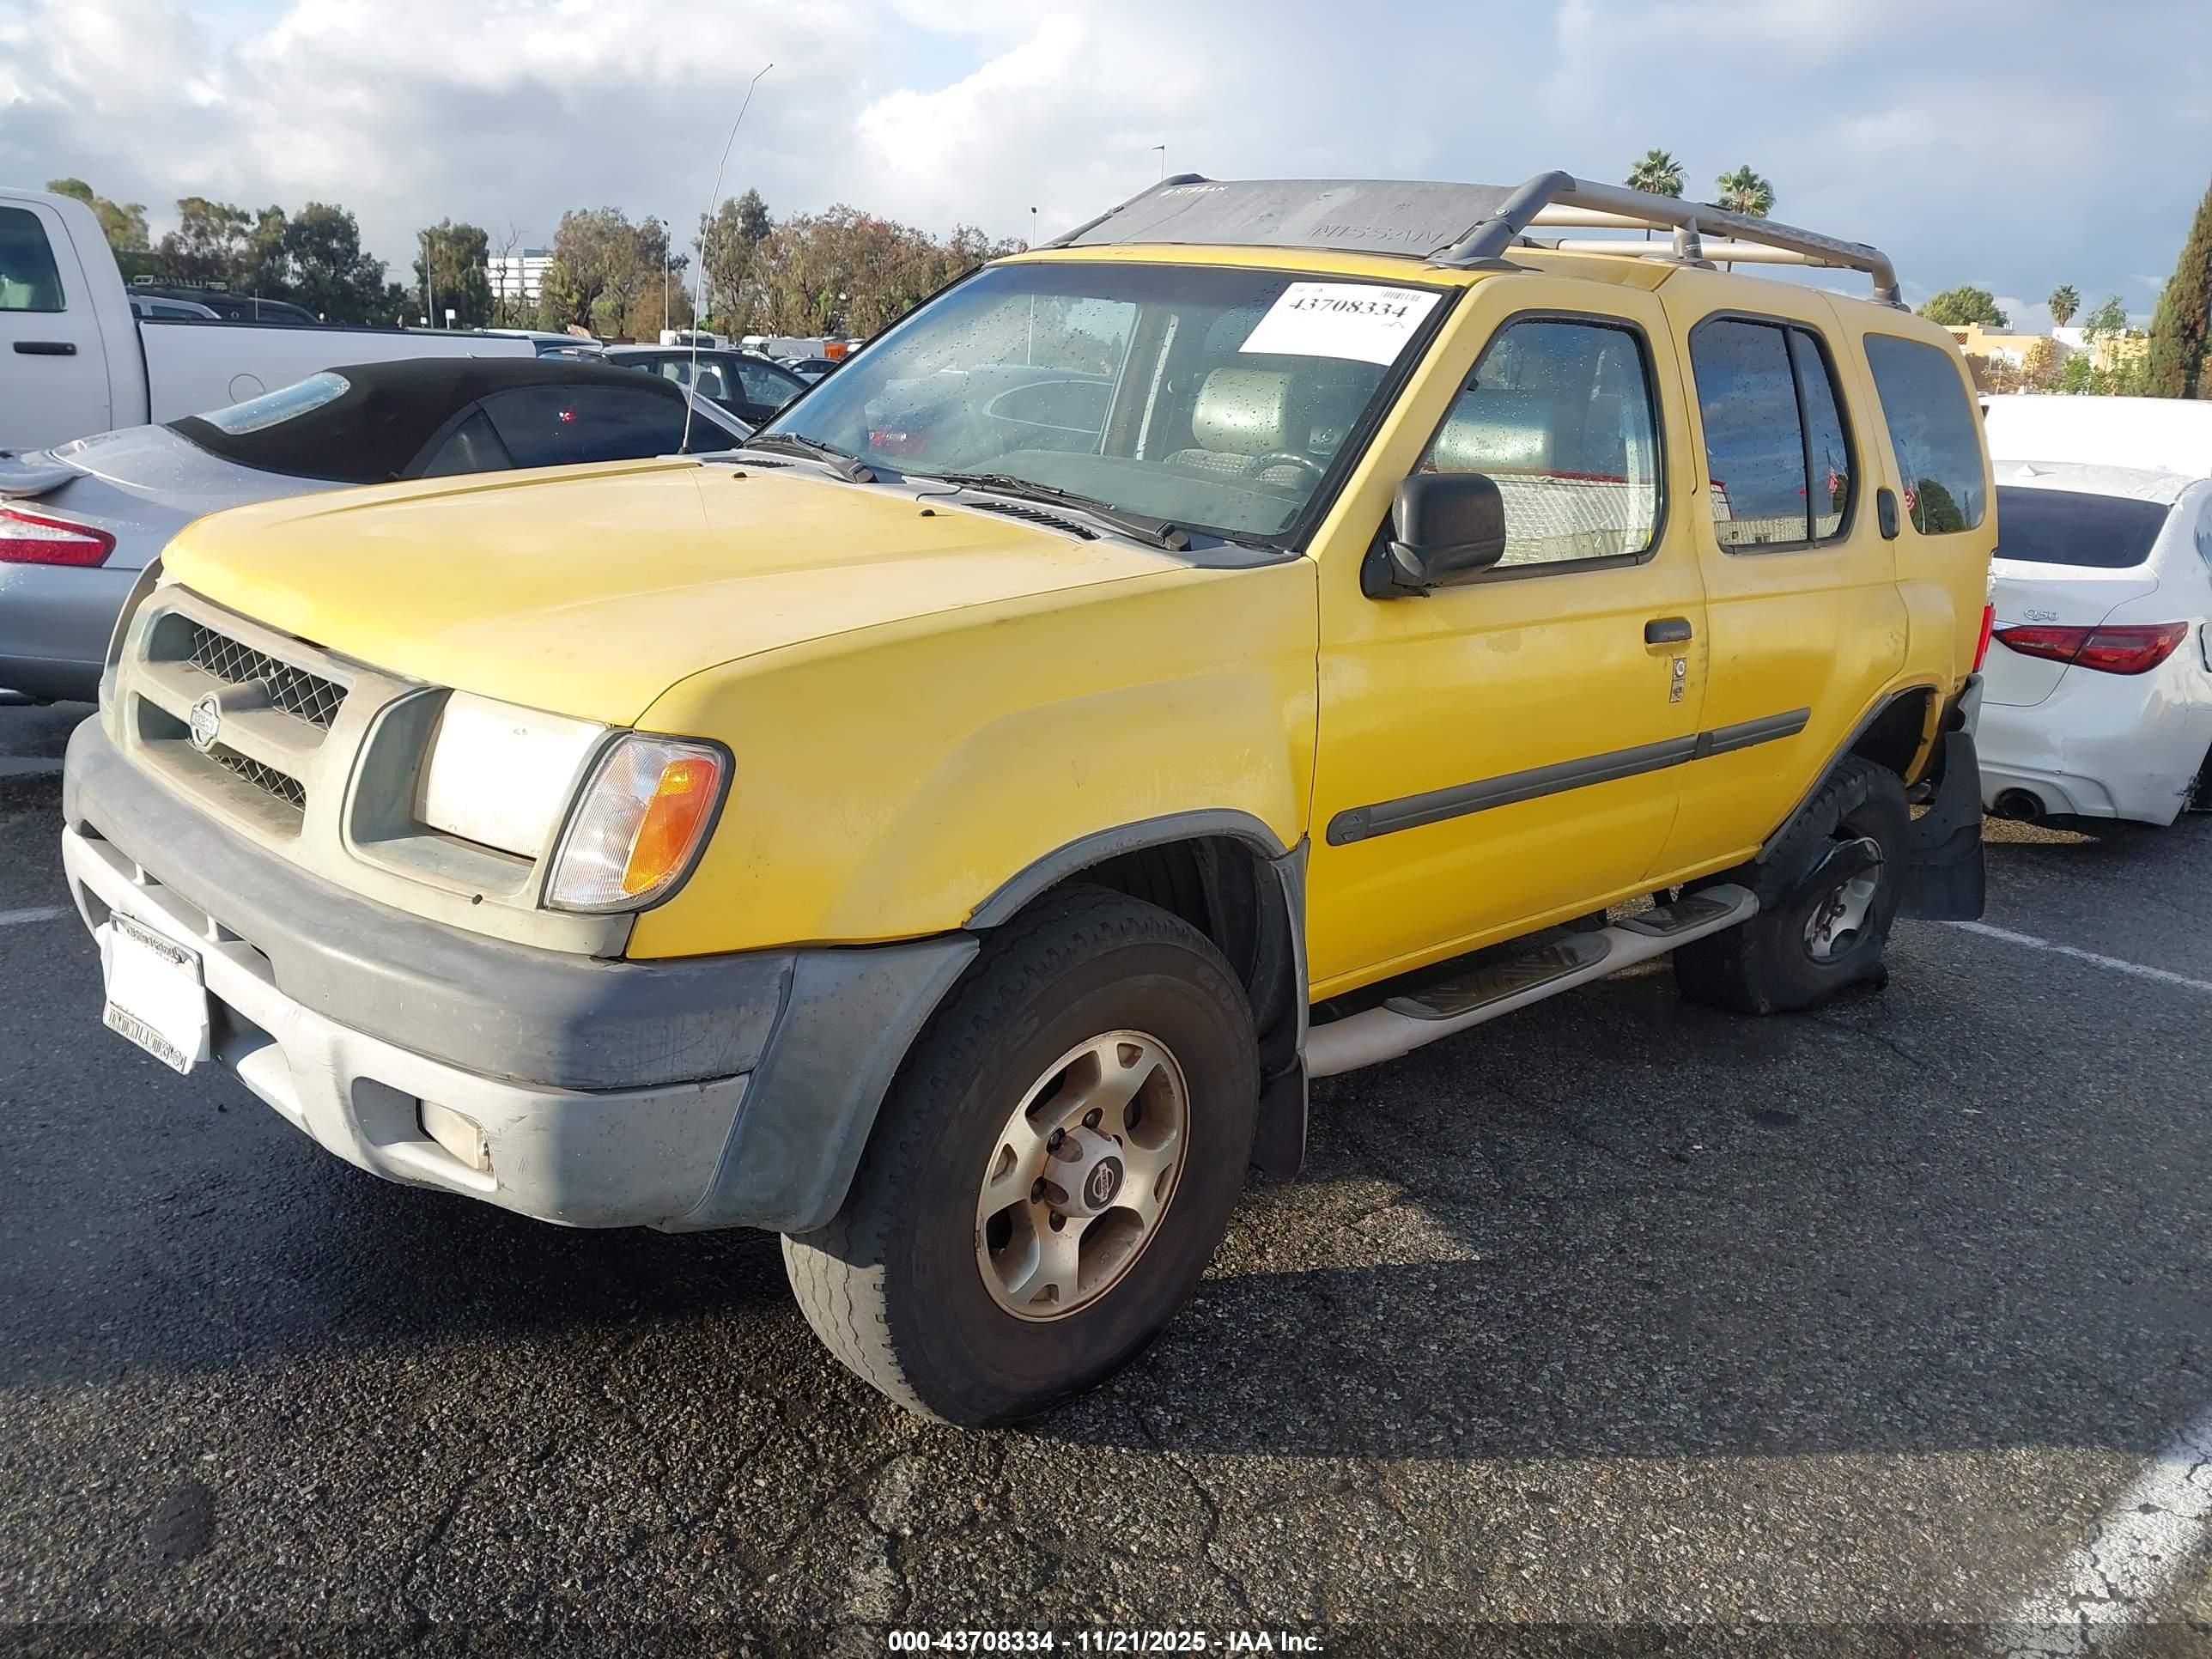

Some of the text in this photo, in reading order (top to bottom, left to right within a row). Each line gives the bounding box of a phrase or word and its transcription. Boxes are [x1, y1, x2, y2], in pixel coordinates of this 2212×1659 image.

[1311, 225, 1443, 245] NISSAN
[1289, 298, 1408, 318] 43708334
[2024, 609, 2059, 622] Q50
